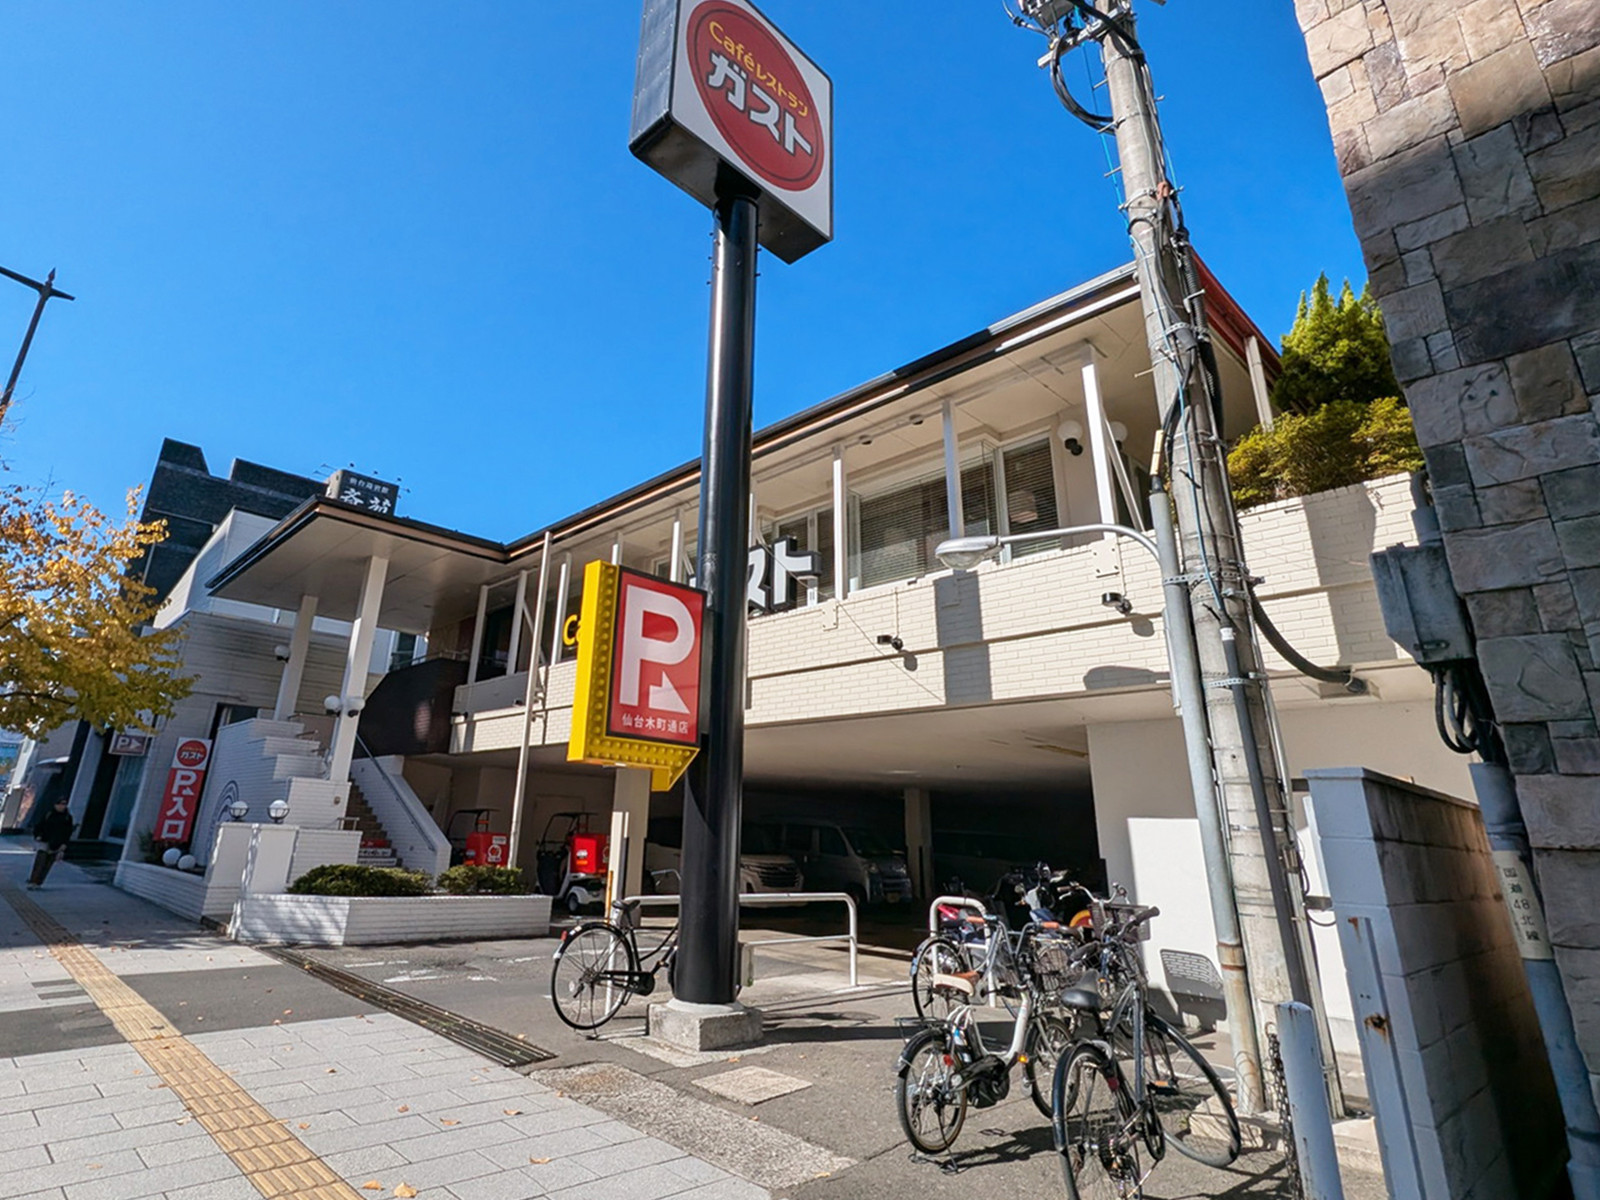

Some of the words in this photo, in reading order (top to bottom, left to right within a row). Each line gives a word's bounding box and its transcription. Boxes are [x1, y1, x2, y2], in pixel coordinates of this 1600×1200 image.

[708, 52, 812, 155] ガスト
[619, 584, 695, 707] P
[622, 713, 689, 734] 仙台木町通店
[171, 770, 197, 795] P
[161, 797, 188, 839] 入口
